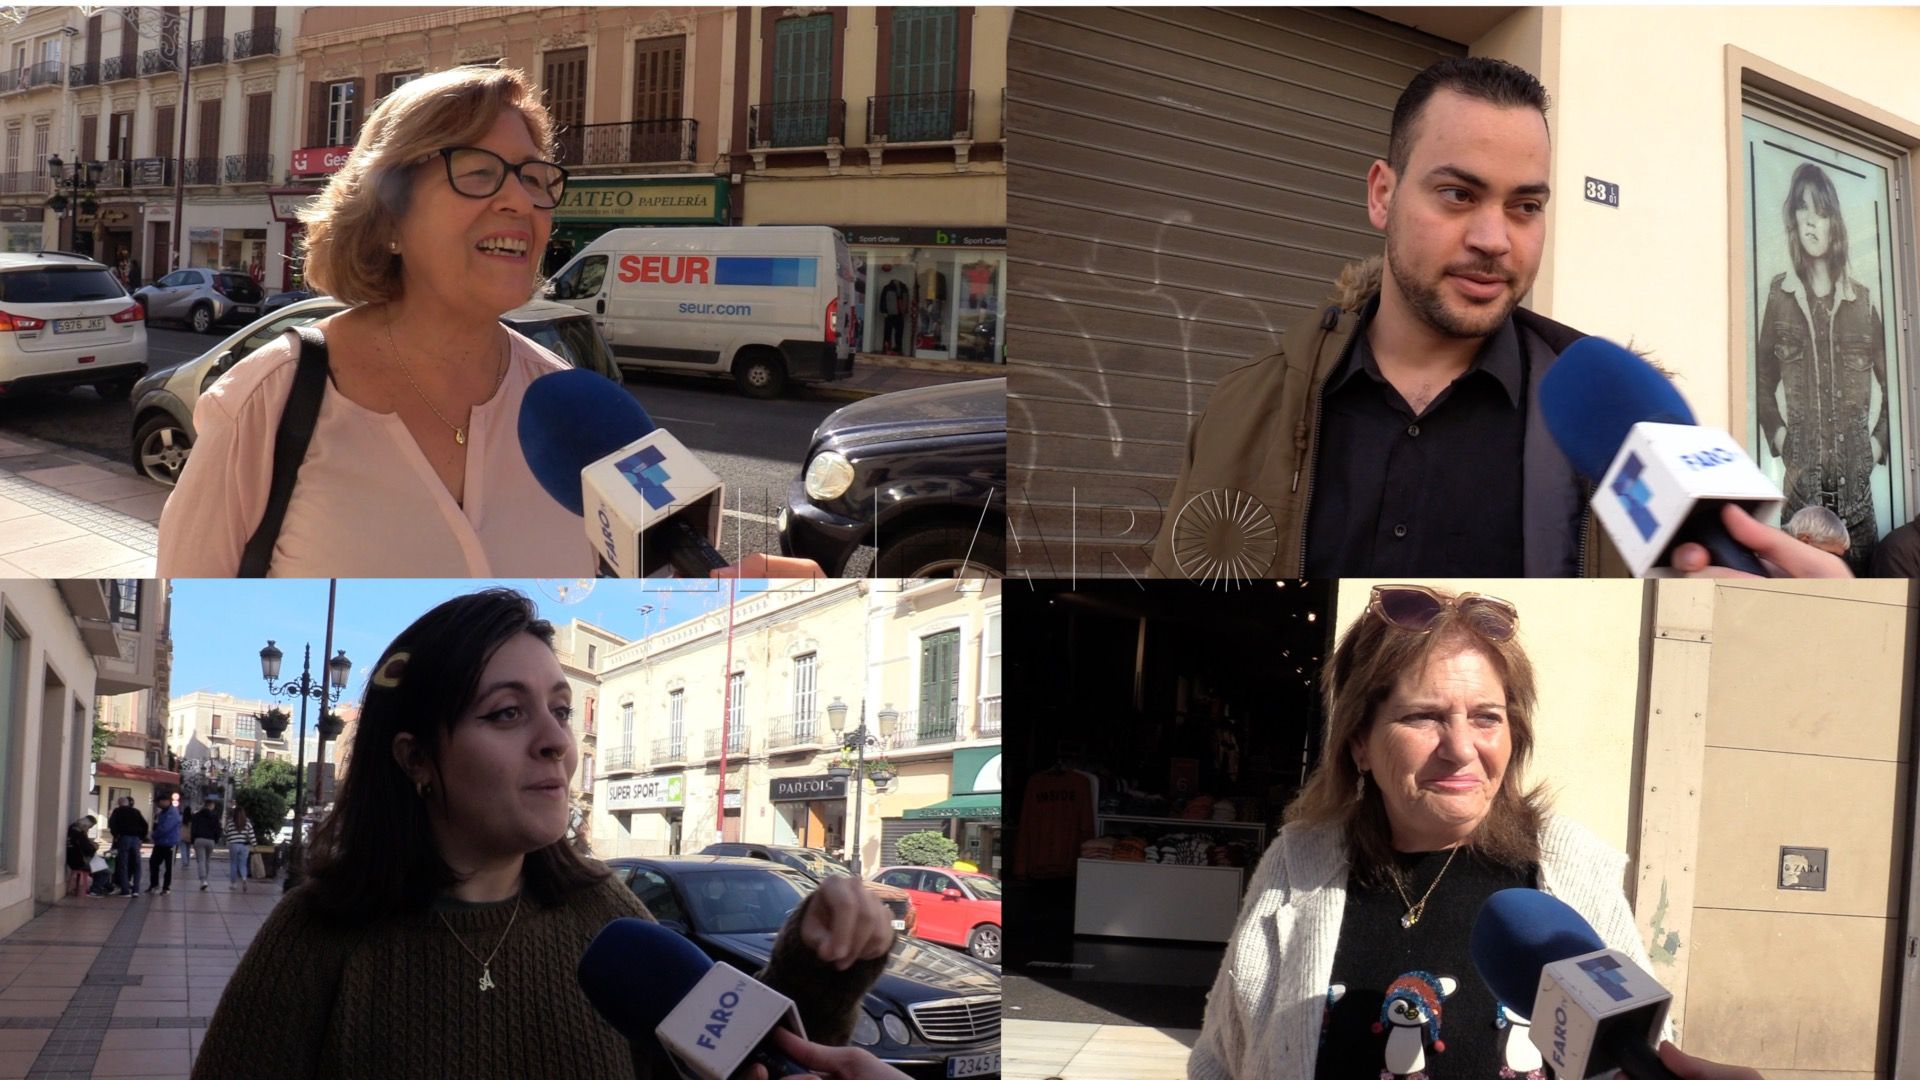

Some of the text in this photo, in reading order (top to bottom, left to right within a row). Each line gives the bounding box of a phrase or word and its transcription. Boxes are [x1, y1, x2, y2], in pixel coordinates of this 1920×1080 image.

[323, 152, 349, 167] Ges
[1586, 181, 1607, 201] 33
[638, 194, 708, 207] PAPELERÍA
[858, 235, 900, 244] Sport Center
[963, 236, 984, 245] Sport
[617, 255, 710, 284] SEUR
[678, 302, 752, 316] seur.com
[598, 509, 619, 567] FARO
[609, 782, 659, 800] SUPER SPORT
[778, 780, 833, 795] PARFOIS
[1793, 864, 1820, 872] ZARA
[696, 991, 740, 1050] FARO
[1553, 1006, 1568, 1067] FARO
[958, 1056, 990, 1074] 2345
